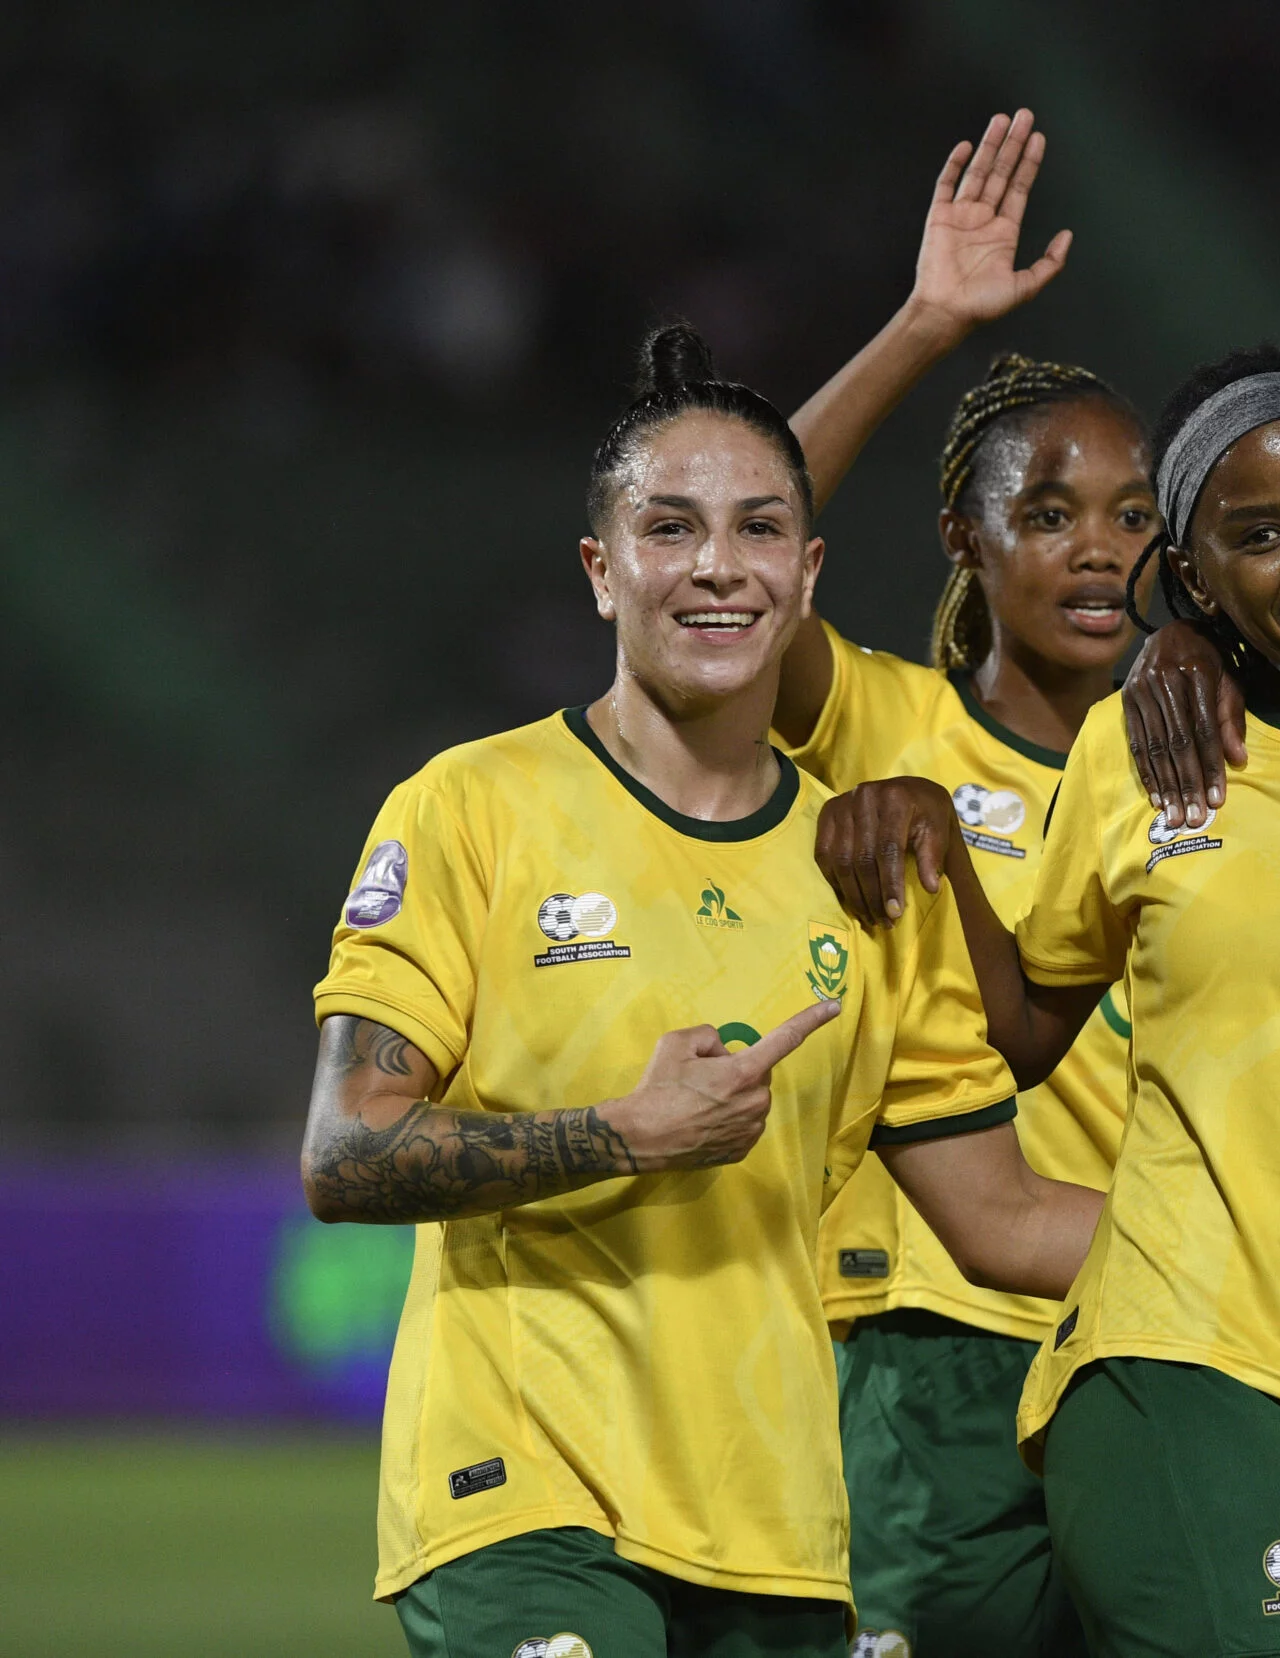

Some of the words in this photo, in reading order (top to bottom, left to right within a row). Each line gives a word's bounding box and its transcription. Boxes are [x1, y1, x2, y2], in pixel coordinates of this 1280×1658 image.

[1172, 842, 1220, 855] ASSOCIATION
[1174, 837, 1206, 849] AFRICAN
[549, 946, 577, 955] SOUTH
[578, 942, 613, 952] AFRICAN
[536, 954, 576, 965] FOOTBALL
[577, 949, 629, 960] ASSOCIATION
